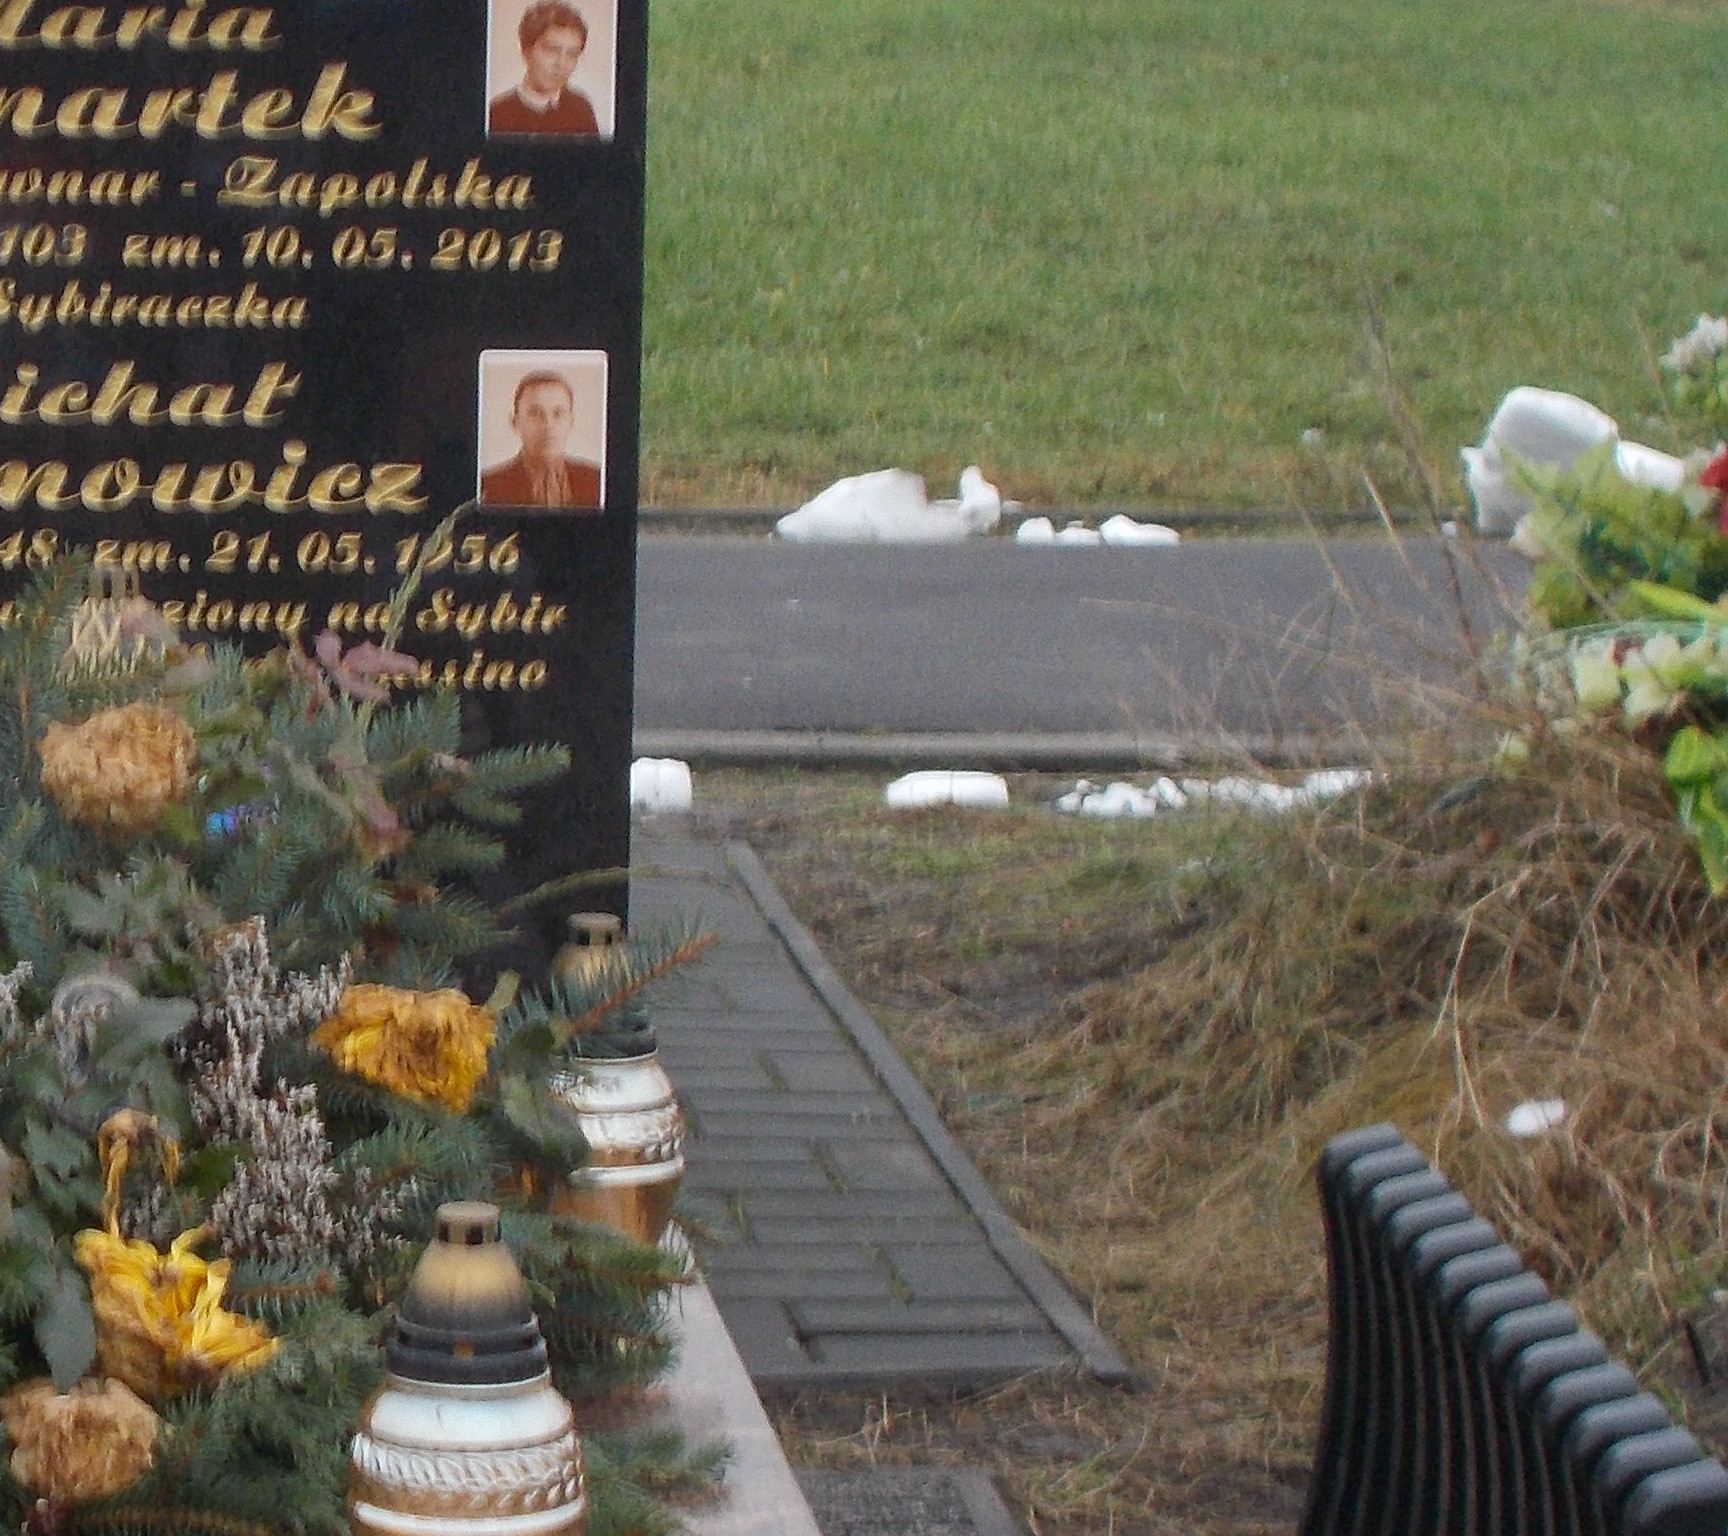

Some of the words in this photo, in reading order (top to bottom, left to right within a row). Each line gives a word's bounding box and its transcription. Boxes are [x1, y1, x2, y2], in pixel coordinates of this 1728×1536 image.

[216, 155, 535, 218] Zapolska
[122, 233, 220, 269] zm.
[430, 227, 564, 272] 2013
[327, 600, 395, 634] na
[415, 586, 568, 641] Sybir
